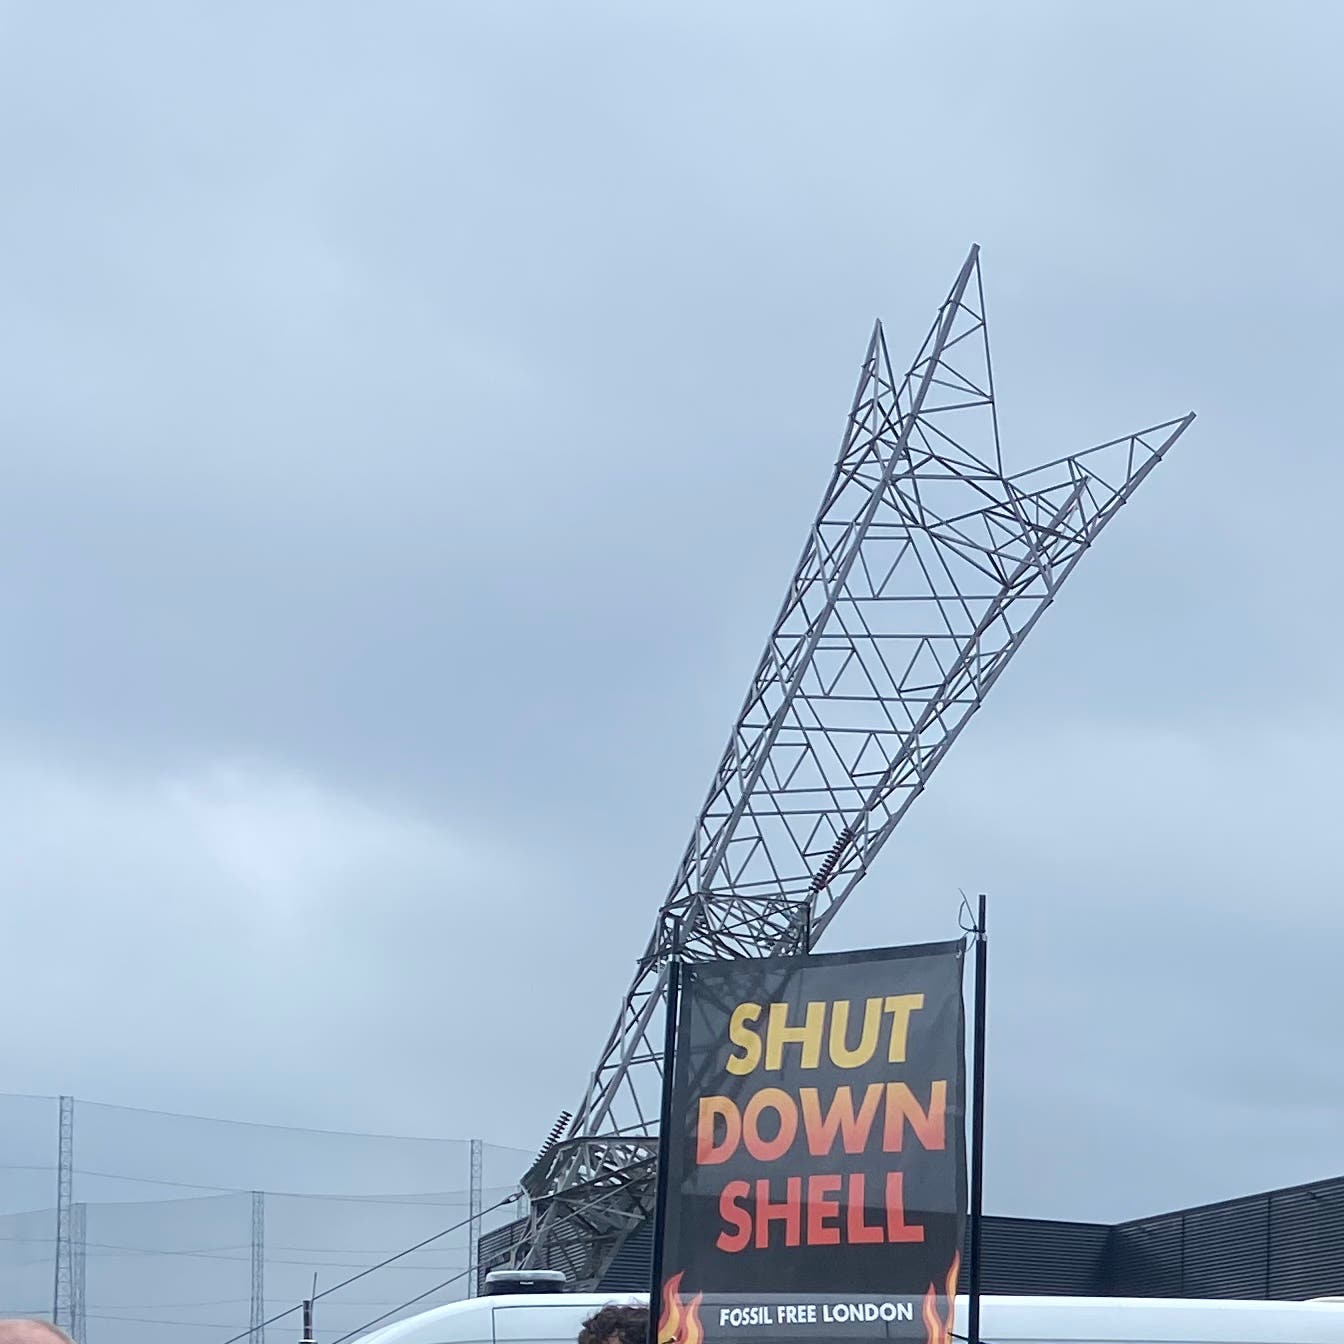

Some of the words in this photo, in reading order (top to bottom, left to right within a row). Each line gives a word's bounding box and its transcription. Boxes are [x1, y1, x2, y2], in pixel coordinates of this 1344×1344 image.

[726, 994, 925, 1075] SHUT
[696, 1080, 947, 1165] DOWN
[716, 1172, 925, 1252] SHELL
[719, 1308, 771, 1327] FOSSIL
[777, 1305, 817, 1324] FREE
[823, 1303, 913, 1323] LONDON
